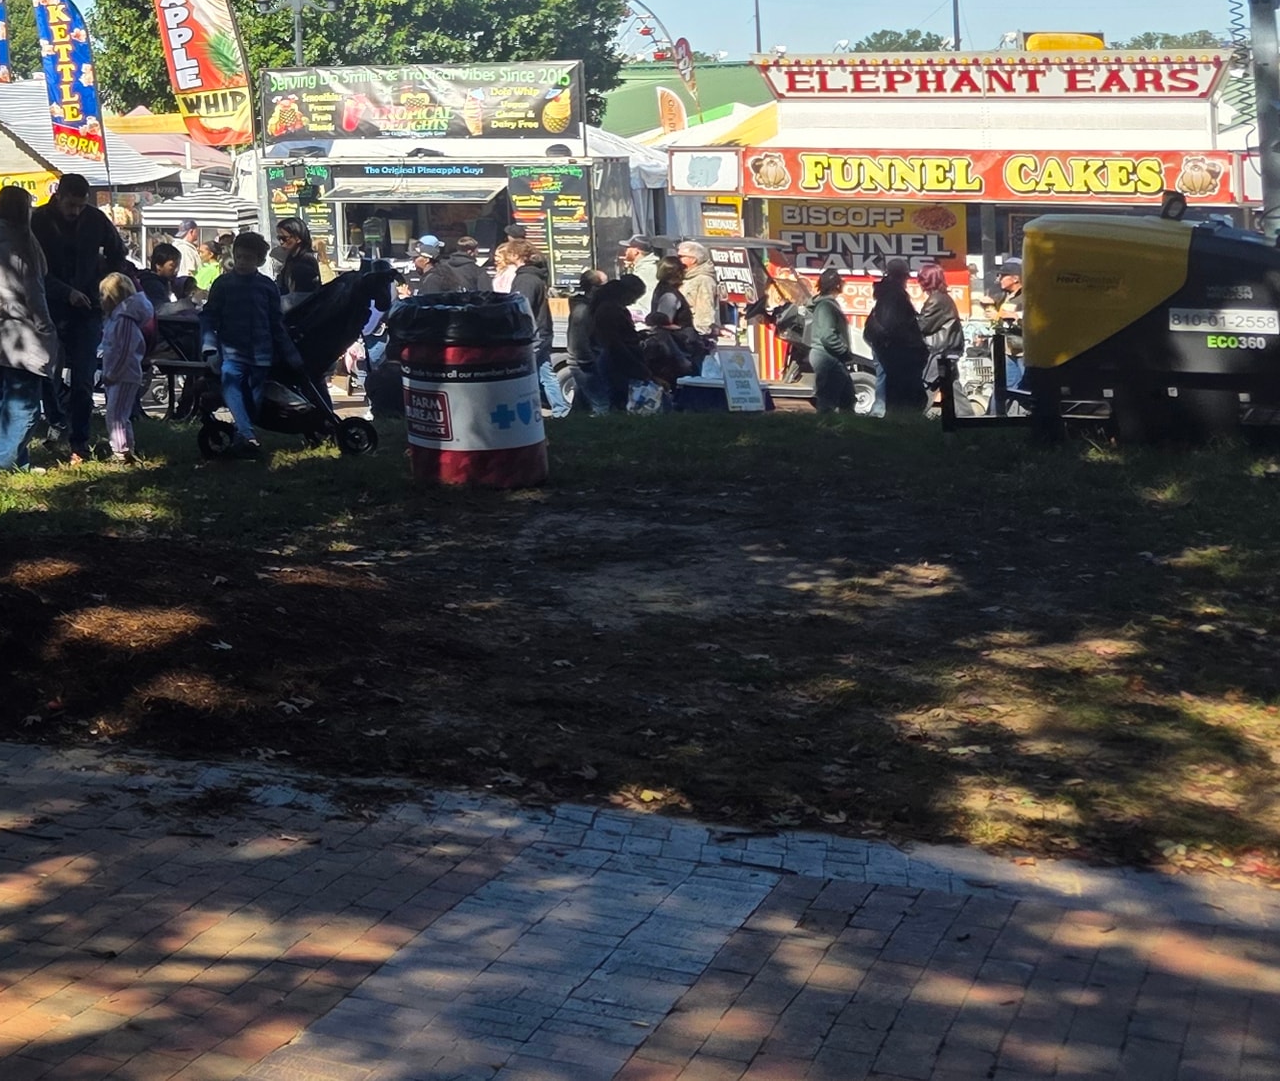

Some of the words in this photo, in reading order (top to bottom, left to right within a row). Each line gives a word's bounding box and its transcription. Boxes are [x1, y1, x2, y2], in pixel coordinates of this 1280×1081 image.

[47, 4, 83, 122] KETTLE
[270, 74, 316, 92] Serving
[342, 71, 382, 84] Smiles
[386, 70, 398, 81] &
[402, 69, 456, 82] Tropical
[460, 69, 496, 81] Vibes
[499, 69, 536, 82] Since
[538, 70, 571, 86] 2015
[785, 68, 1048, 94] ELEPHANT
[1064, 68, 1201, 94] EARS
[301, 92, 343, 103] Smoothies
[513, 87, 540, 97] Whip
[181, 91, 248, 114] WHIP
[372, 106, 455, 120] TROPICAL
[378, 119, 449, 132] DELIGHTS
[490, 119, 517, 130] Dairy
[517, 119, 539, 128] Free
[56, 131, 100, 156] CORN
[364, 166, 380, 175] The
[381, 166, 416, 176] Original
[417, 166, 461, 177] Pineapple
[462, 166, 484, 175] Guys
[800, 153, 983, 194] FUNNEL
[1005, 155, 1164, 195] CAKES
[781, 205, 904, 227] BISCOFF
[779, 230, 956, 258] FUNNEL
[710, 250, 728, 263] DEEP
[728, 250, 744, 264] FRY
[795, 252, 937, 277] CAKS
[714, 266, 753, 285] PUMPKIN
[725, 281, 746, 294] PIE
[1171, 313, 1277, 329] 810-01-2558
[1206, 335, 1266, 350] ECO360
[446, 369, 457, 379] all
[458, 371, 472, 379] our
[473, 369, 505, 378] member
[411, 393, 443, 411] FARM
[406, 405, 444, 423] BUREAU
